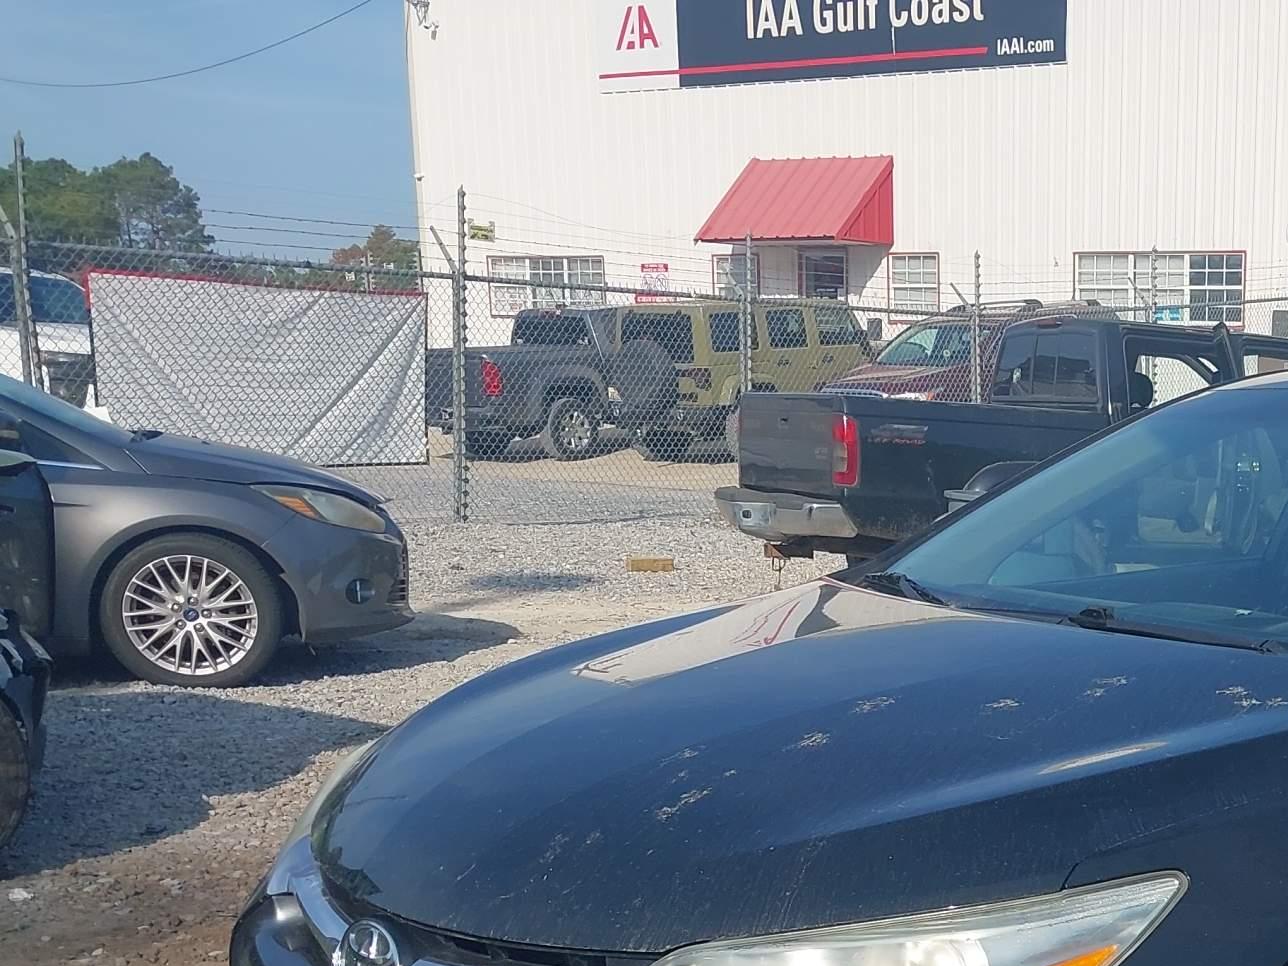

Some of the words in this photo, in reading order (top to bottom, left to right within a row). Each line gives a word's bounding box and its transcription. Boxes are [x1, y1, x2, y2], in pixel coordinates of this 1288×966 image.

[746, 0, 804, 40] IAA
[812, 0, 878, 34] Gulf
[888, 0, 985, 28] Coast
[996, 37, 1055, 57] IAAI.com
